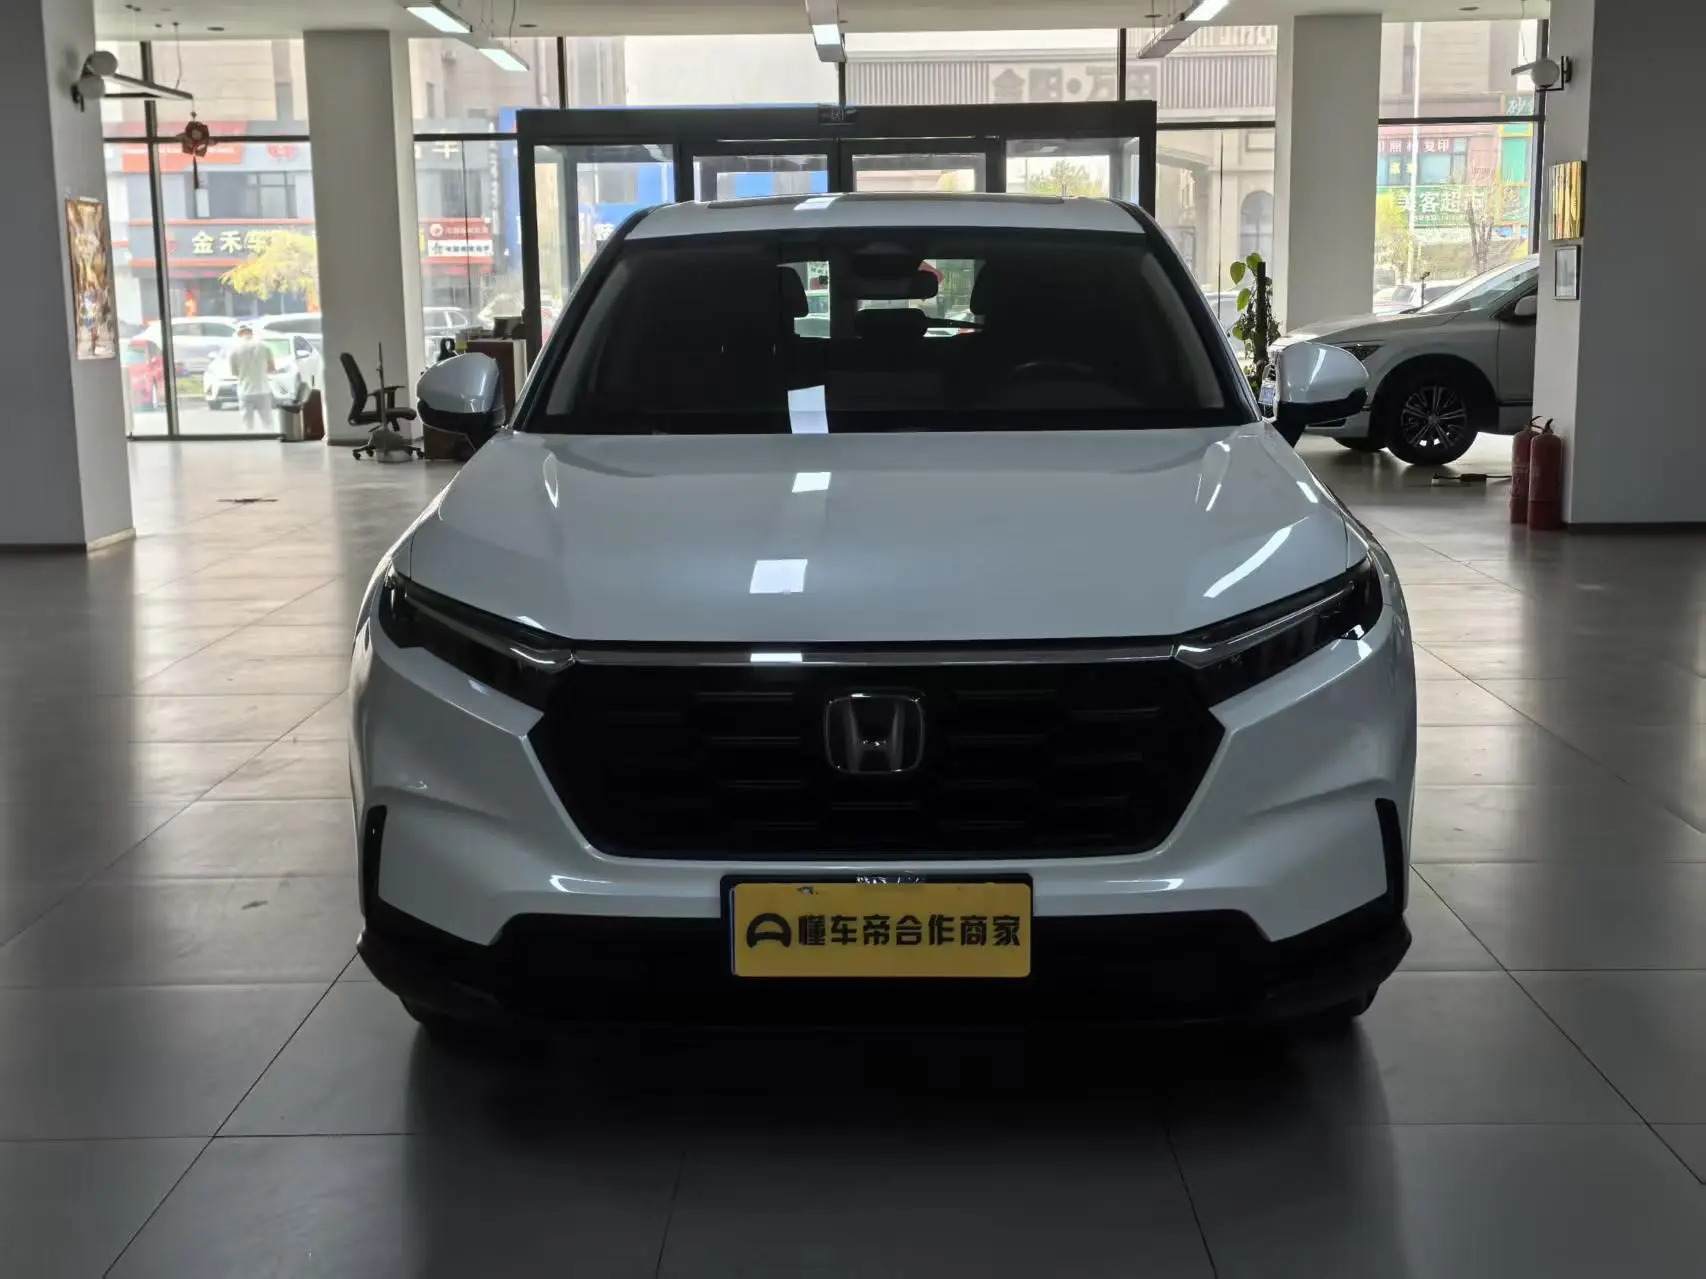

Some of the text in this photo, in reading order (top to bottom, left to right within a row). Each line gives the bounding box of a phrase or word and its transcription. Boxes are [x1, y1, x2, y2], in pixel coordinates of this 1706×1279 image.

[798, 914, 1021, 946] 懂车帝合作商家
